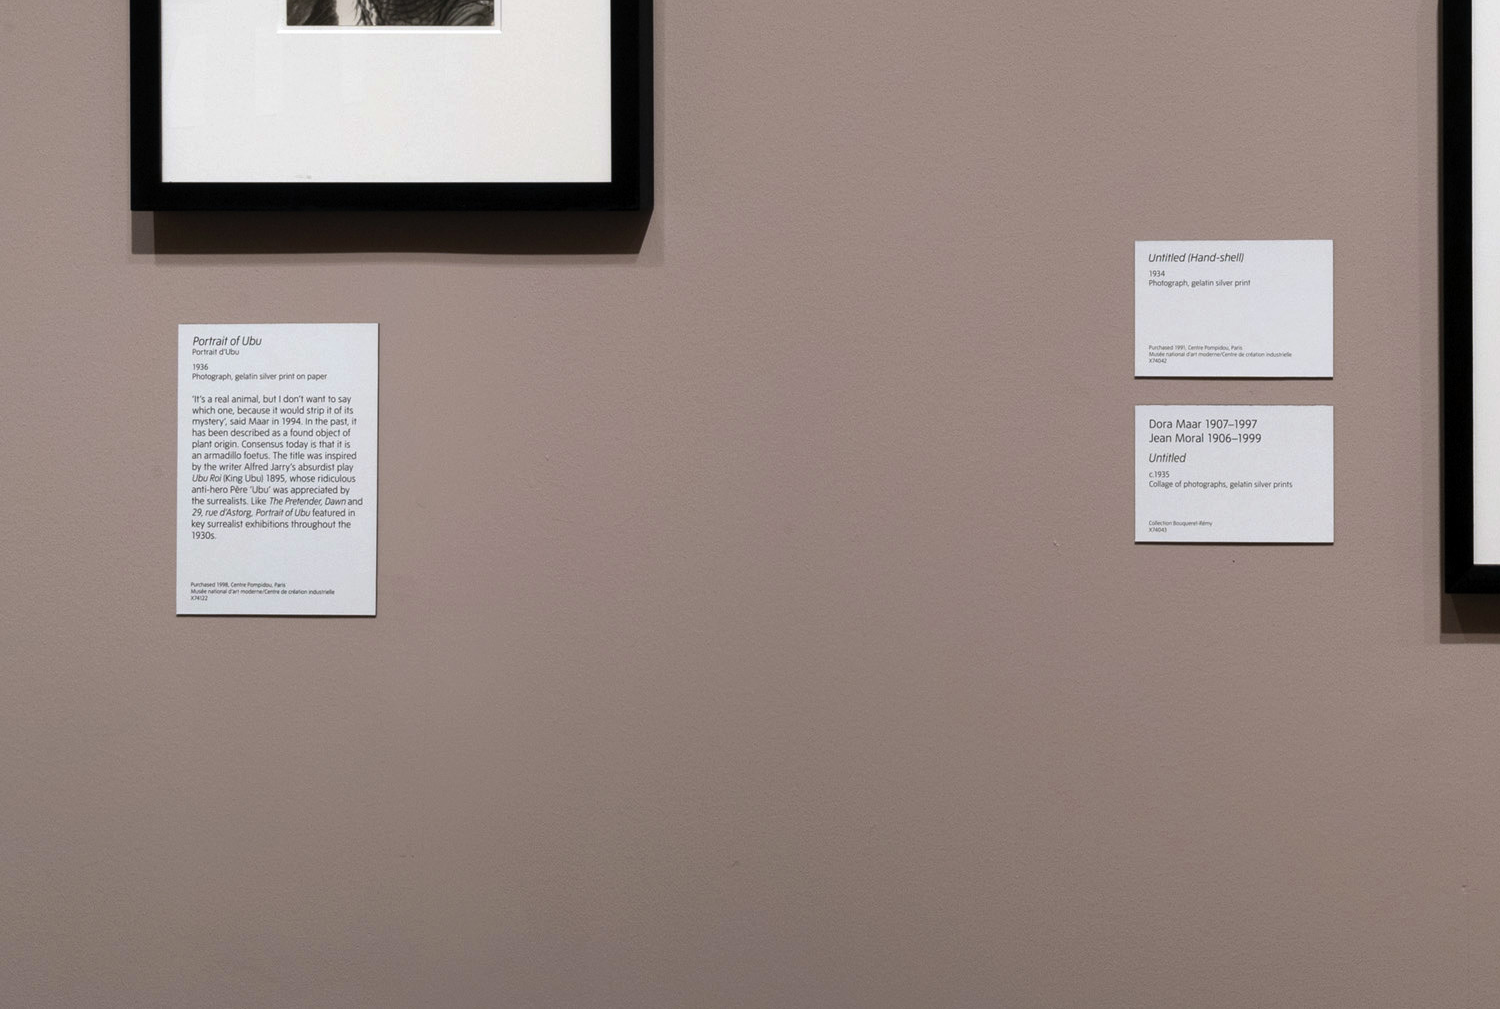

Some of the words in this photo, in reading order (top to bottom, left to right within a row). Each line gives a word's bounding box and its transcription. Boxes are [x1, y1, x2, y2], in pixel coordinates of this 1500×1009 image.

[1148, 253, 1187, 262] Untitled
[1188, 253, 1245, 263] (Hand-shell)
[1148, 280, 1190, 288] Photograph,
[1191, 280, 1214, 288] gelatin
[1234, 280, 1251, 288] print
[192, 336, 228, 346] Portrait
[230, 336, 241, 346] of
[242, 336, 262, 346] Ubu
[192, 348, 218, 356] Portrait
[192, 373, 233, 382] Photograph,
[234, 373, 258, 382] gelatin
[278, 373, 295, 381] print
[214, 395, 230, 403] real
[231, 395, 261, 404] animal,
[263, 395, 277, 403] but
[278, 395, 282, 403] I
[338, 396, 352, 405] say
[192, 406, 216, 415] which
[237, 406, 271, 414] because
[279, 406, 305, 414] would
[306, 407, 325, 416] strip
[326, 406, 332, 414] it
[333, 406, 342, 414] of
[344, 406, 354, 414] its
[229, 418, 247, 426] said
[248, 418, 270, 426] Maar
[282, 418, 304, 426] 1994.
[314, 418, 328, 426] the
[330, 418, 350, 427] past,
[1149, 419, 1173, 429] Dora
[1176, 419, 1202, 429] Maar
[192, 428, 206, 437] has
[208, 428, 229, 437] been
[230, 429, 270, 437] described
[290, 428, 314, 437] found
[315, 429, 341, 438] object
[342, 429, 351, 437] of
[1149, 433, 1172, 443] Jean
[1175, 433, 1204, 443] Moral
[192, 440, 212, 449] plant
[214, 440, 239, 450] origin.
[241, 440, 284, 448] Consensus
[286, 440, 308, 450] today
[319, 440, 335, 448] that
[337, 440, 342, 448] it
[344, 440, 351, 448] is
[203, 451, 242, 460] armadillo
[243, 451, 270, 460] foetus.
[273, 451, 288, 460] The
[289, 451, 305, 460] title
[325, 452, 357, 461] inspired
[1148, 453, 1187, 463] Untitled
[192, 463, 202, 472] by
[204, 463, 217, 471] the
[219, 463, 242, 471] writer
[244, 463, 269, 471] Alfred
[298, 463, 335, 471] absurdist
[337, 463, 354, 472] play
[192, 474, 209, 482] Ubu
[209, 474, 222, 482] Roi
[223, 474, 243, 484] (King
[245, 474, 264, 483] Ubu)
[266, 474, 288, 483] 1895,
[289, 474, 316, 483] whose
[317, 474, 356, 483] ridiculous
[1149, 481, 1174, 489] Collage
[1174, 480, 1182, 488] of
[1183, 481, 1228, 489] photographs,
[1230, 481, 1253, 490] gelatin
[1273, 481, 1293, 489] prints
[191, 486, 229, 494] anti-hero
[230, 486, 248, 494] Père
[290, 486, 338, 495] appreciated
[340, 486, 350, 496] by
[191, 497, 205, 505] the
[206, 497, 249, 505] surrealists.
[251, 497, 267, 505] Like
[270, 497, 284, 505] The
[284, 497, 323, 506] Pretender,
[324, 497, 347, 506] Dawn
[347, 498, 364, 506] and
[192, 508, 203, 517] 29,
[256, 509, 284, 517] Portrait
[285, 508, 294, 517] of
[295, 508, 311, 517] Ubu
[312, 508, 346, 517] featured
[191, 520, 206, 530] key
[207, 520, 243, 528] surrealist
[245, 520, 289, 528] exhibitions
[291, 520, 336, 530] throughout
[338, 520, 352, 529] the
[192, 531, 217, 540] 1930s.
